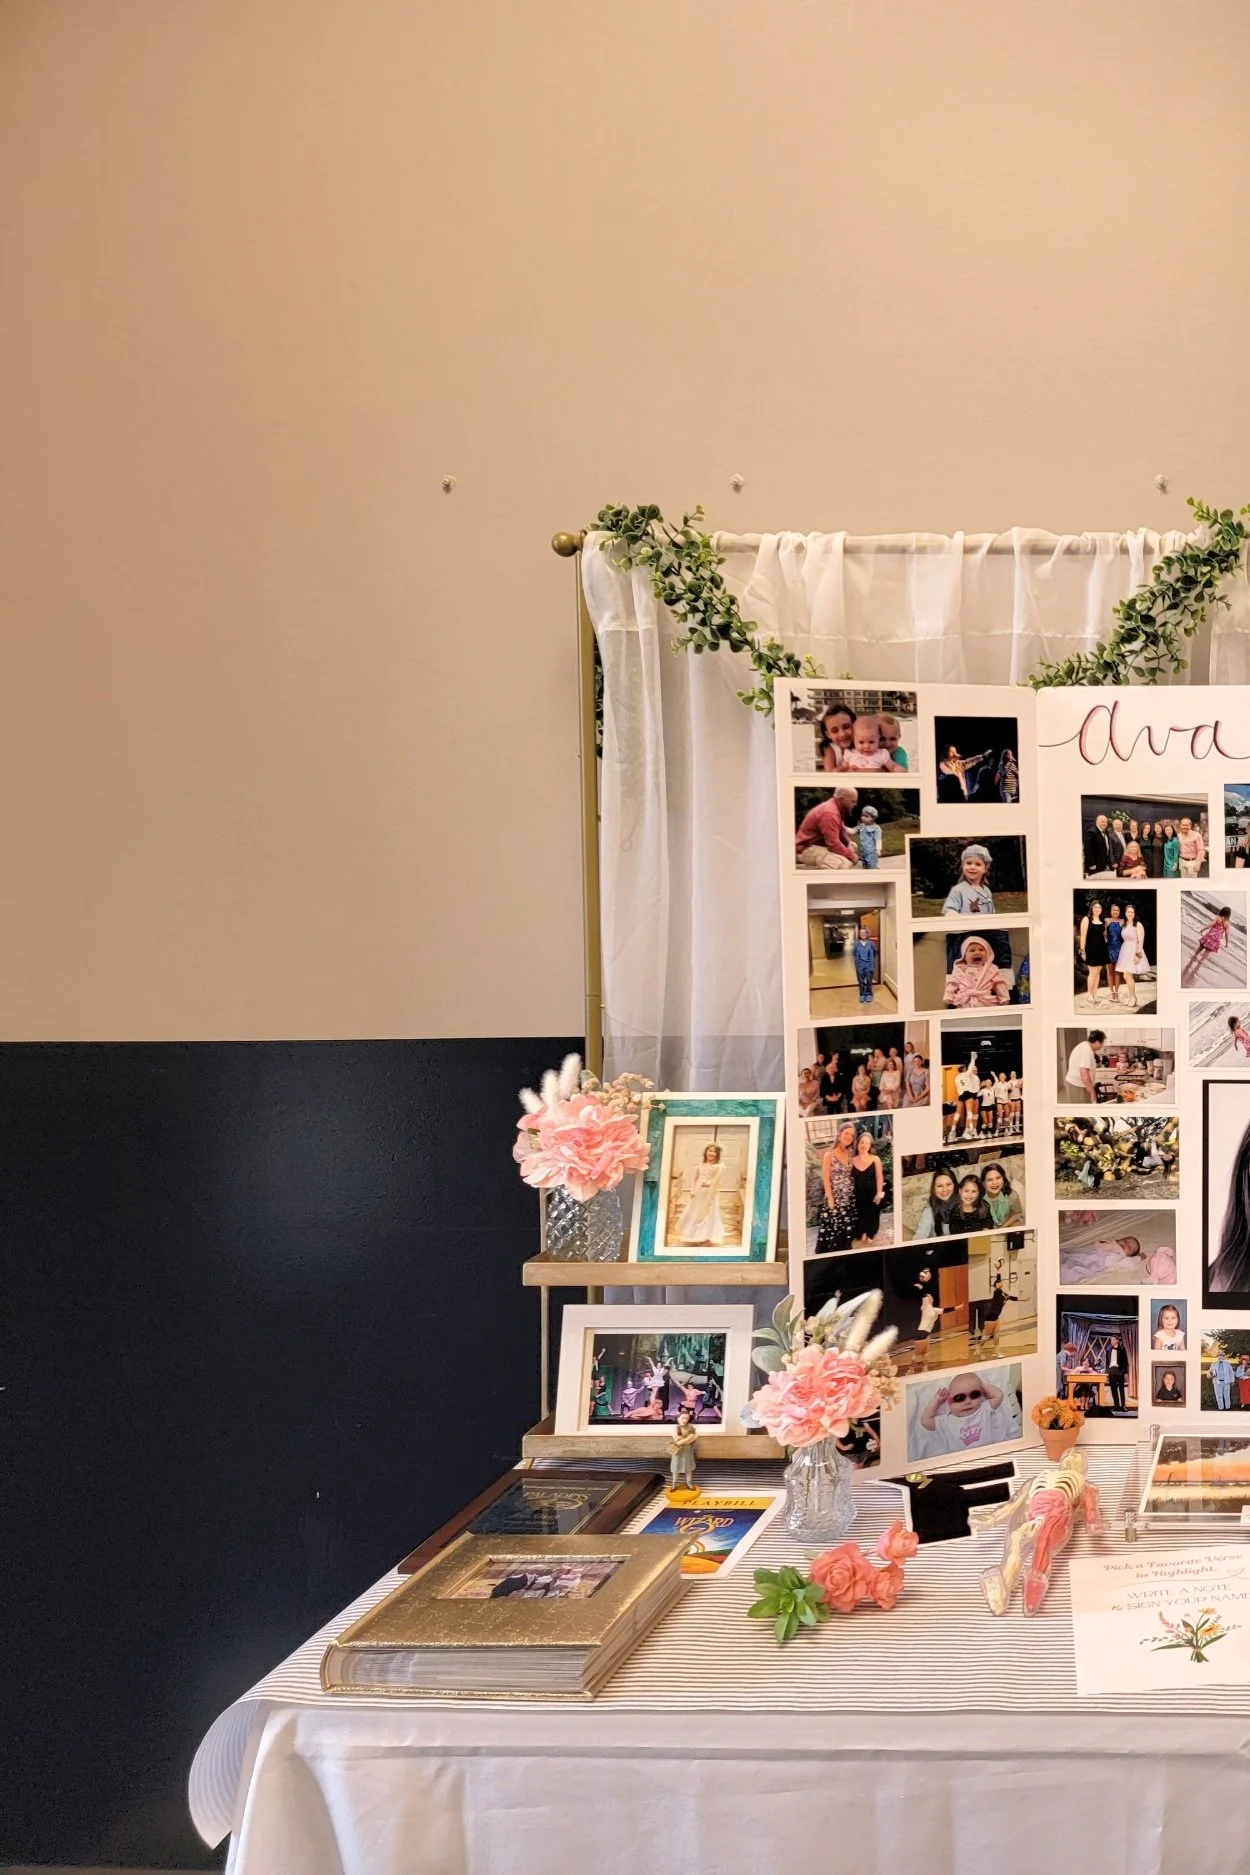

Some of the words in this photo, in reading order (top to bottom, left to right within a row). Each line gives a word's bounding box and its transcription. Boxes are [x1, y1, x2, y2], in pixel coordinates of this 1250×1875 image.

[674, 1514, 735, 1528] WIZARD
[1103, 1563, 1133, 1571] Pick
[1147, 1559, 1202, 1568] Favorite
[1205, 1554, 1243, 1562] Verse
[1152, 1565, 1217, 1578] Highlight
[1127, 1588, 1176, 1600] WRITE
[1194, 1583, 1233, 1593] NOTE
[1127, 1599, 1161, 1610] SIGN
[1164, 1596, 1208, 1606] YOUR
